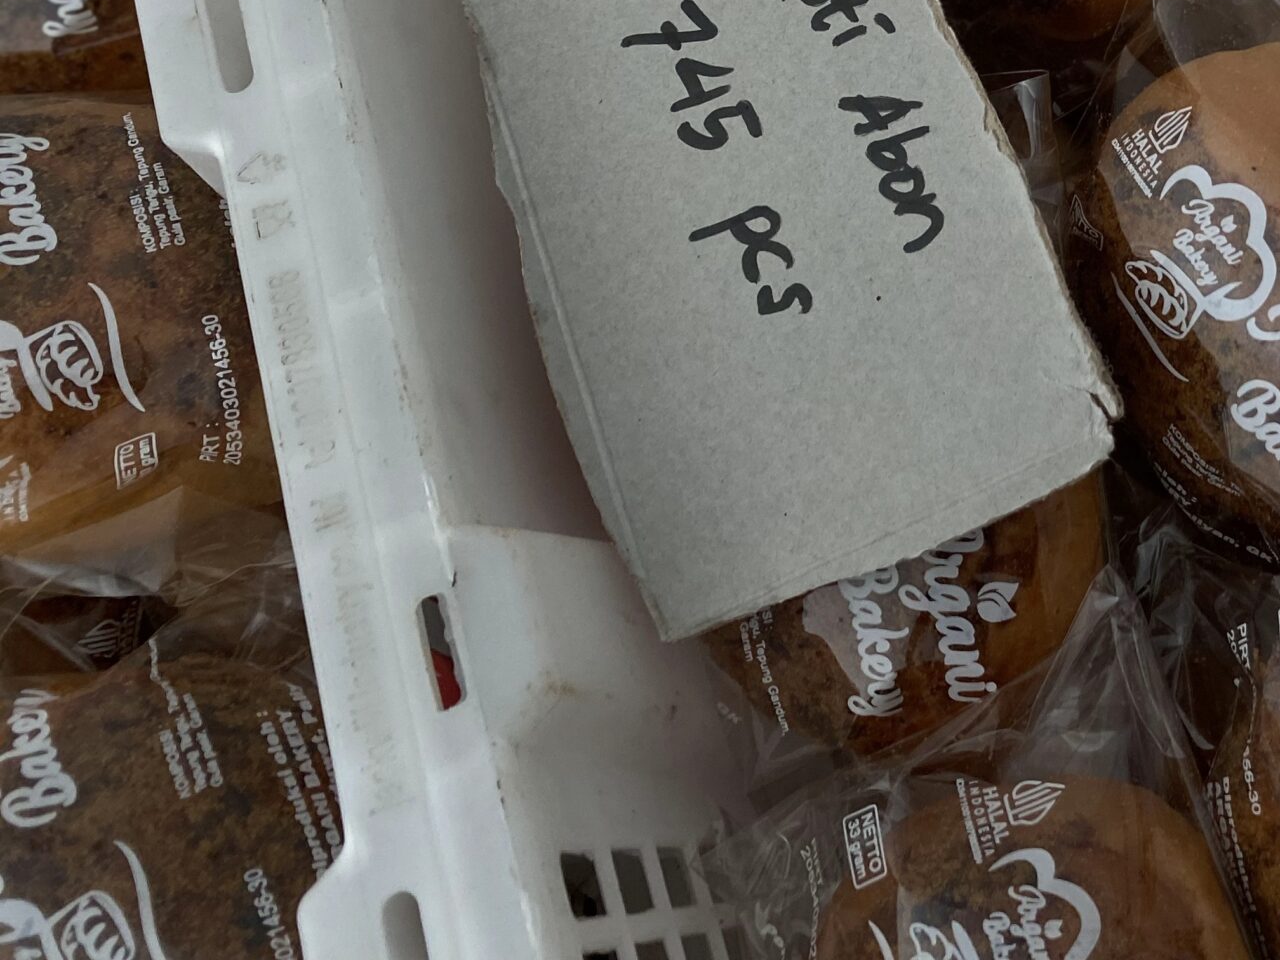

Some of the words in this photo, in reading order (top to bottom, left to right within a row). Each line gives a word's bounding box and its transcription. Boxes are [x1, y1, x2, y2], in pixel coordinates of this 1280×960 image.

[133, 146, 150, 181] Tepung
[1121, 132, 1158, 189] INDONESIA
[1132, 128, 1163, 174] HALAL
[153, 162, 169, 194] Garam
[838, 95, 945, 253] Abon
[129, 194, 157, 253] KOMPOSISI
[154, 213, 171, 249] Tepung
[171, 222, 186, 246] Gula
[1181, 198, 1244, 266] Argani
[1173, 228, 1218, 286] Bakery
[139, 439, 155, 466] gram
[740, 622, 753, 661] Garam
[755, 640, 773, 684] Tepung
[261, 721, 287, 764] oleh
[276, 708, 320, 788] BAKERY
[847, 819, 861, 839] 33
[968, 780, 996, 856] INDONESIA
[982, 787, 1009, 844] HALAL
[849, 842, 866, 879] gram
[861, 812, 882, 873] NETTO
